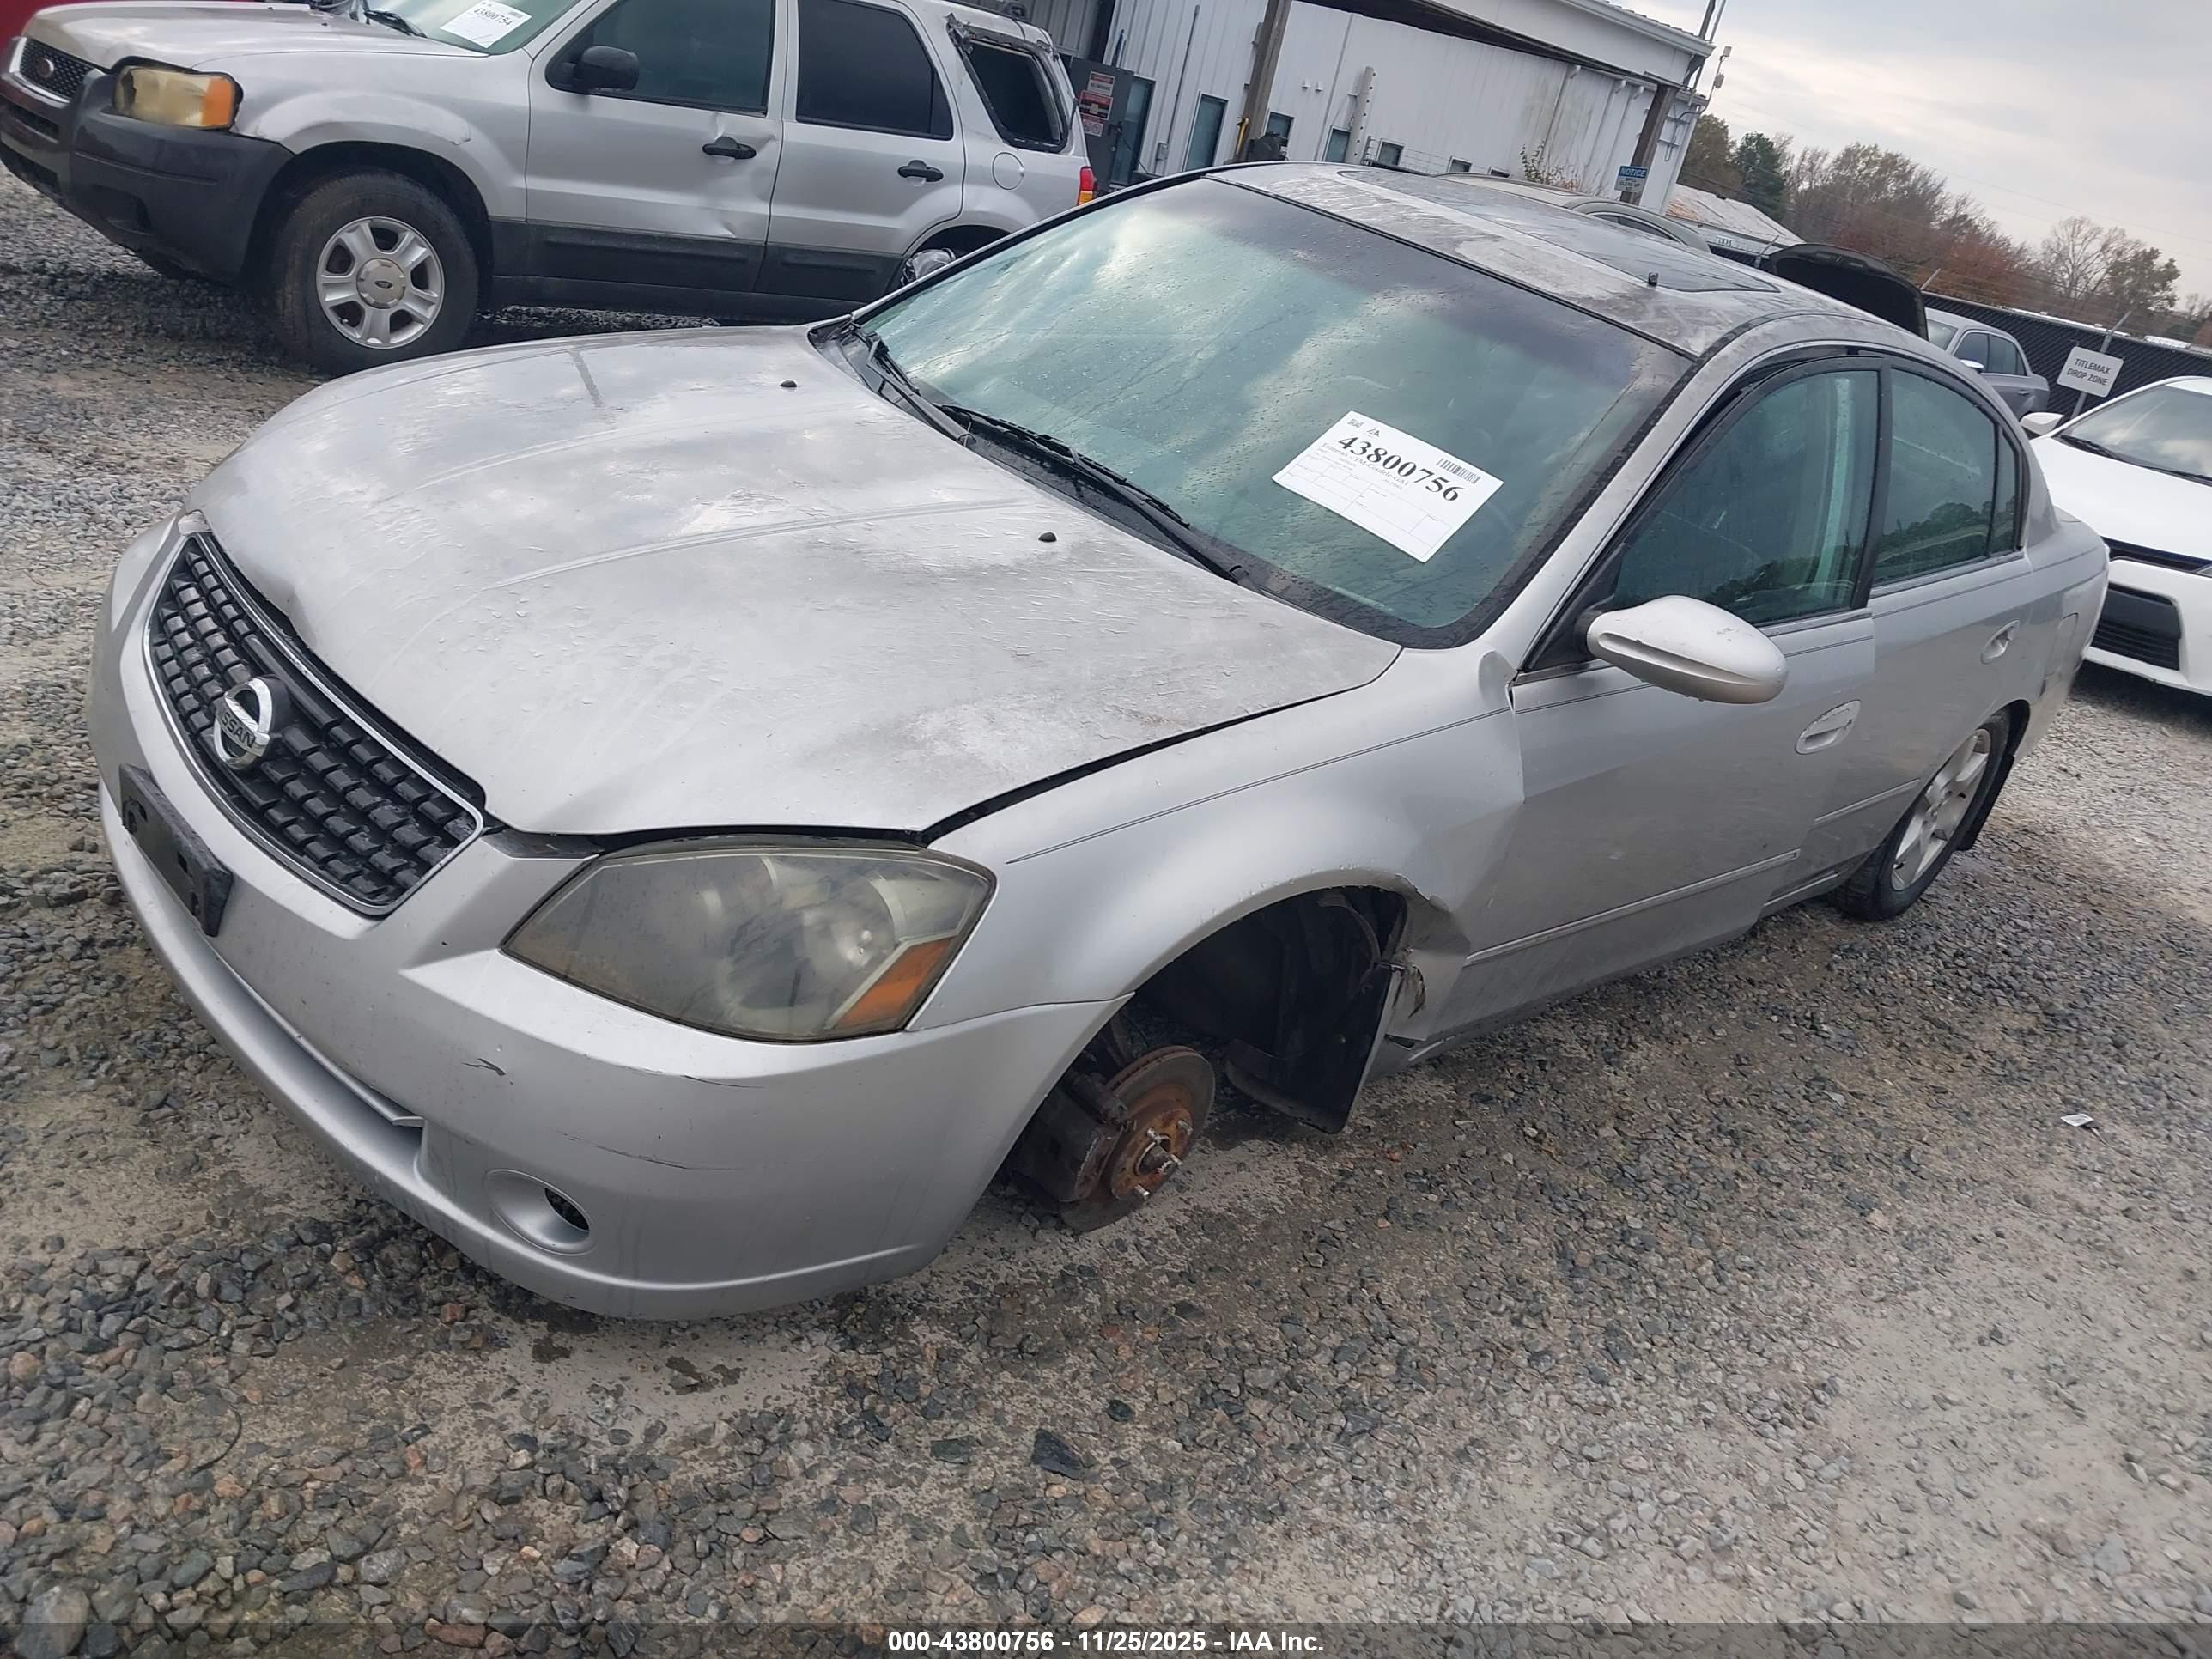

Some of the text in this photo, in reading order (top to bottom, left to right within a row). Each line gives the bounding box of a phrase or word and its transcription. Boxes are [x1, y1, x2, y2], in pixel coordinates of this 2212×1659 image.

[1620, 167, 1646, 178] NOTICE
[2074, 357, 2112, 375] TITLEMAX
[2067, 368, 2109, 386] DROP ZONE
[1338, 436, 1467, 501] 43800756
